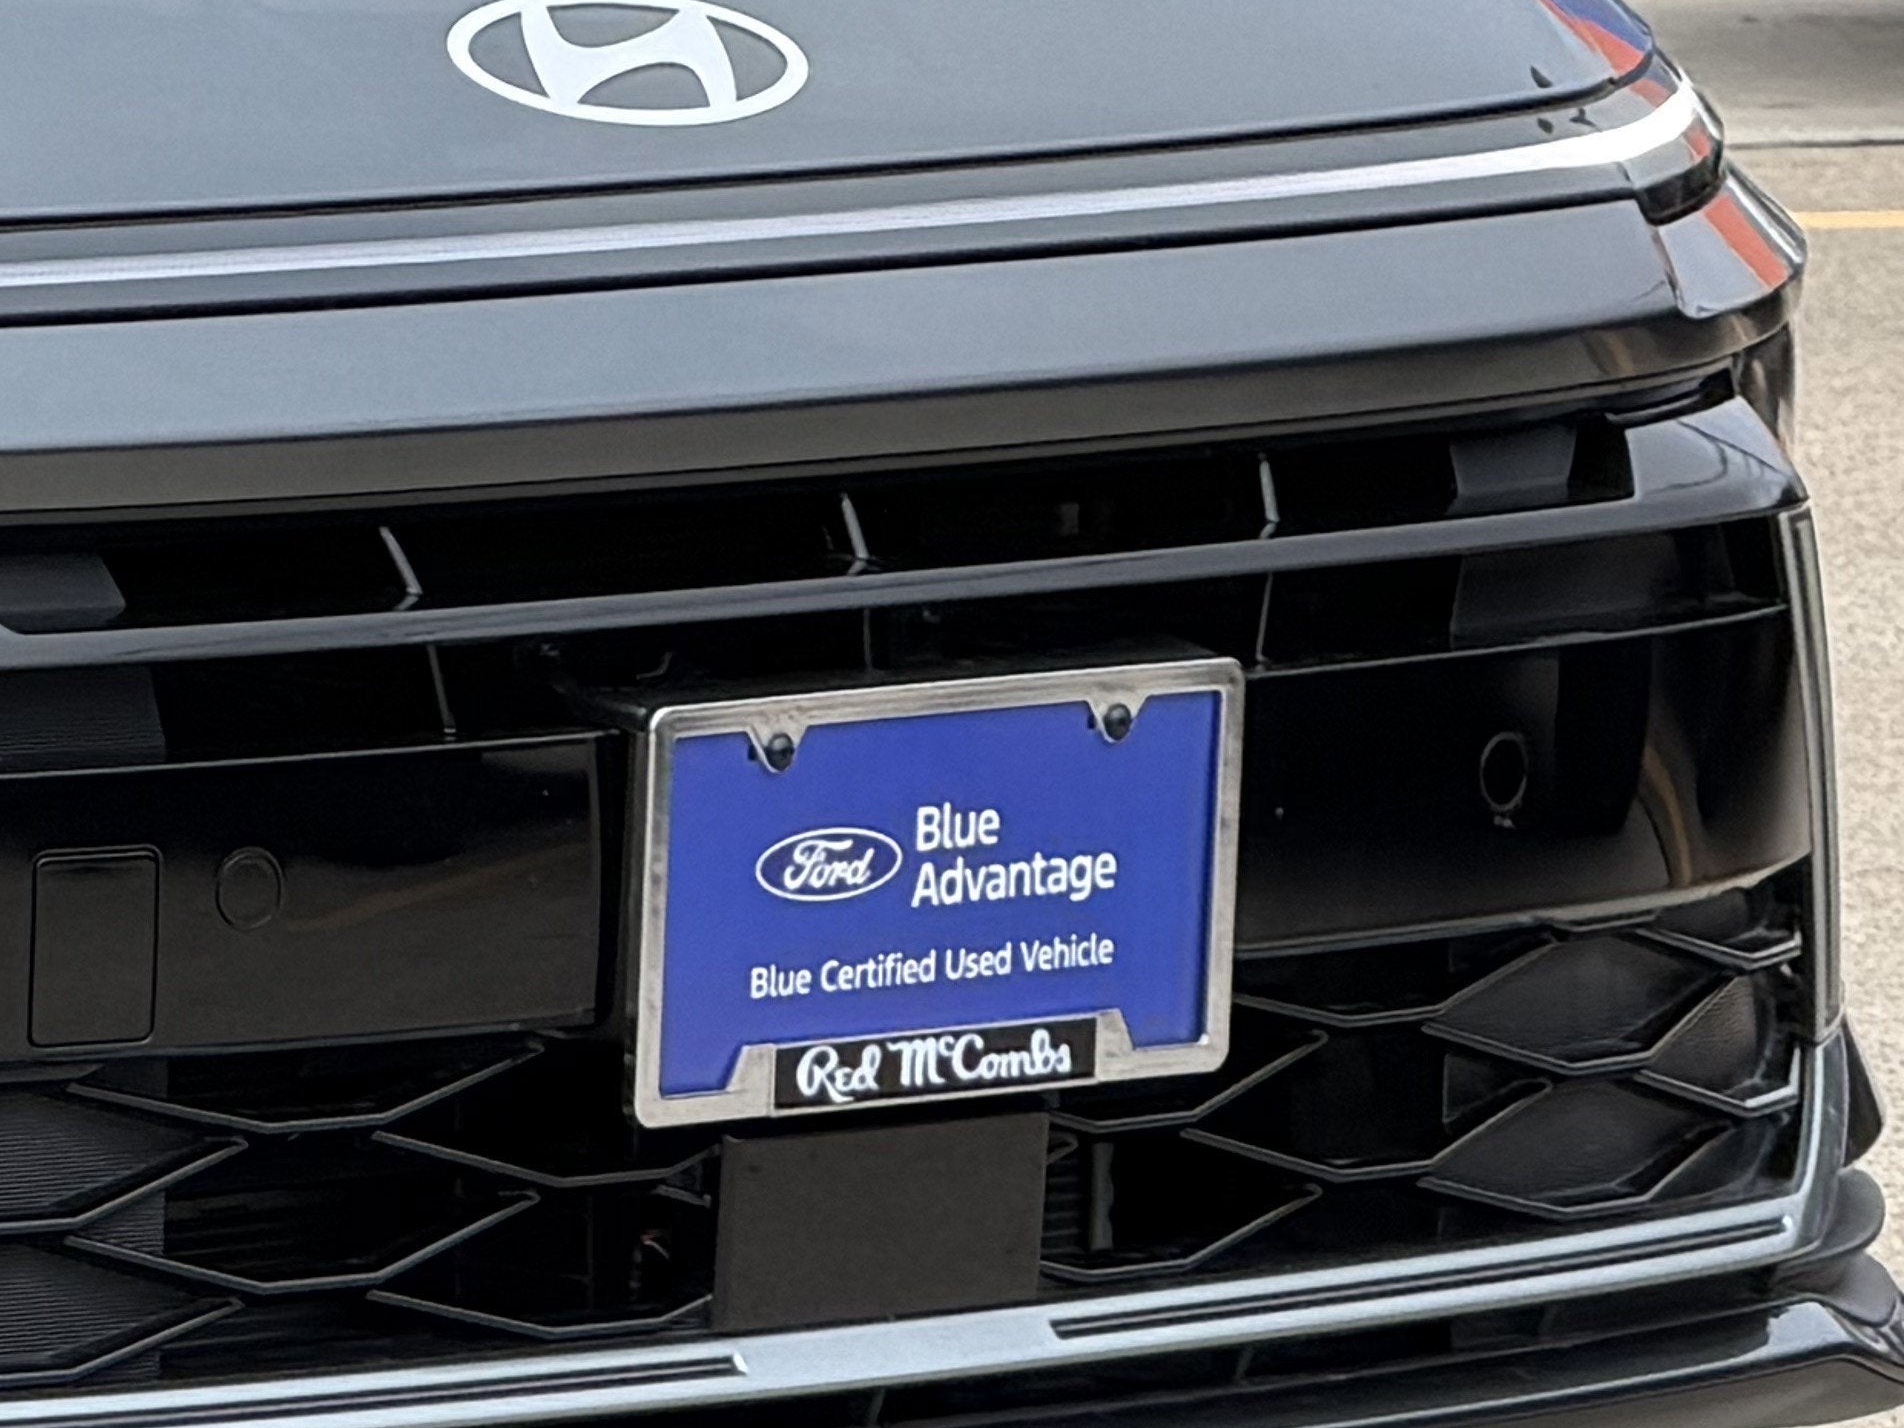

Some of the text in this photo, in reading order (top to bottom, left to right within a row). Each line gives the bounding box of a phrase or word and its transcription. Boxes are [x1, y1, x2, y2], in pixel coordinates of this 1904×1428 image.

[915, 802, 1001, 852] Blue
[783, 838, 876, 890] Ford
[910, 851, 1118, 908] Advantage
[749, 932, 1115, 999] Blue Certified Used Vehicle
[796, 1028, 1073, 1103] Red McCombs
